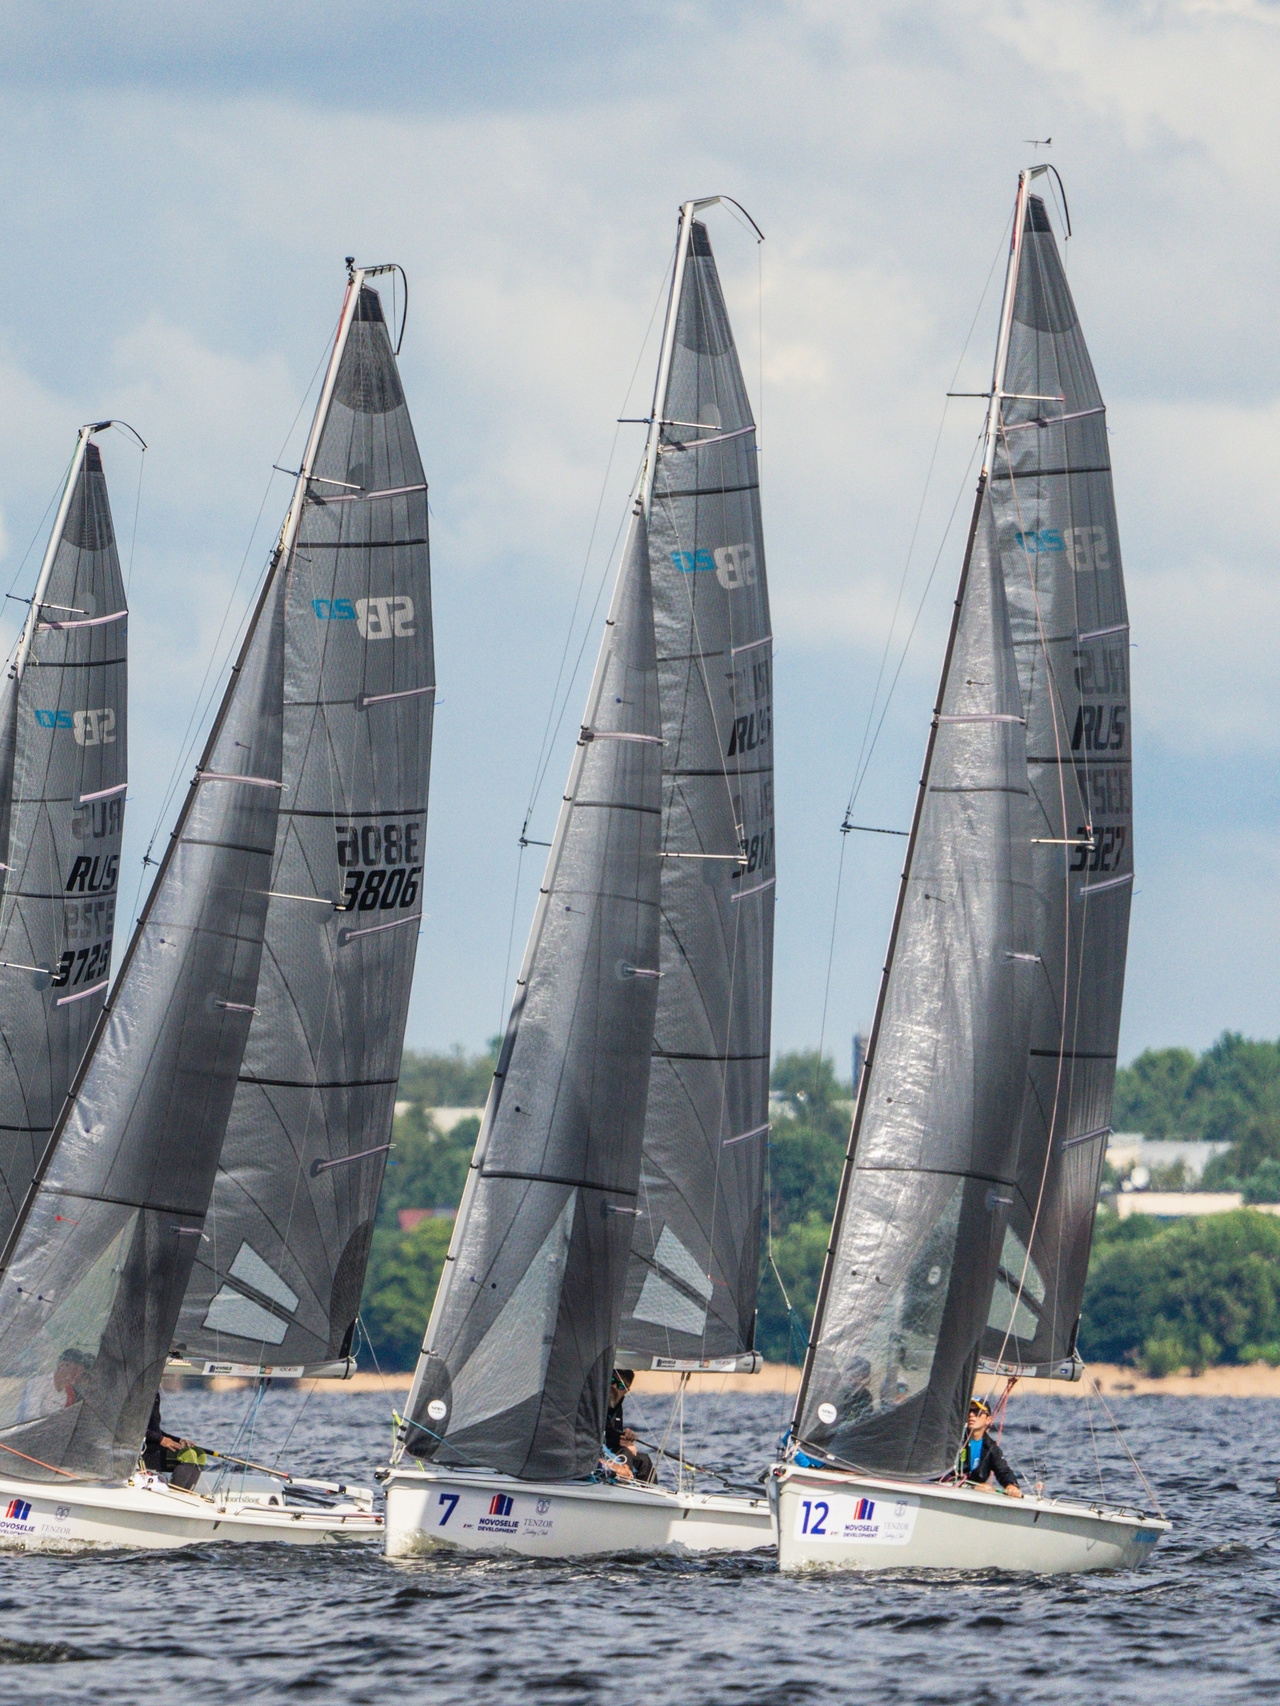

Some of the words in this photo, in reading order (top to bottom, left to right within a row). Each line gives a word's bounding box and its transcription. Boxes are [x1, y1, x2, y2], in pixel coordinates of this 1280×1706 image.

[1070, 705, 1127, 750] RUS
[65, 855, 119, 892] RUS
[333, 866, 422, 912] 3806
[438, 1493, 460, 1527] 7
[478, 1518, 519, 1528] NOVOSELIE
[523, 1519, 554, 1528] TENZOR
[802, 1500, 830, 1535] 12
[41, 1523, 72, 1535] TENZOR
[477, 1525, 518, 1534] DEVELOPMENT
[844, 1524, 879, 1532] NOVOSELIE
[883, 1522, 909, 1530] TENZOR
